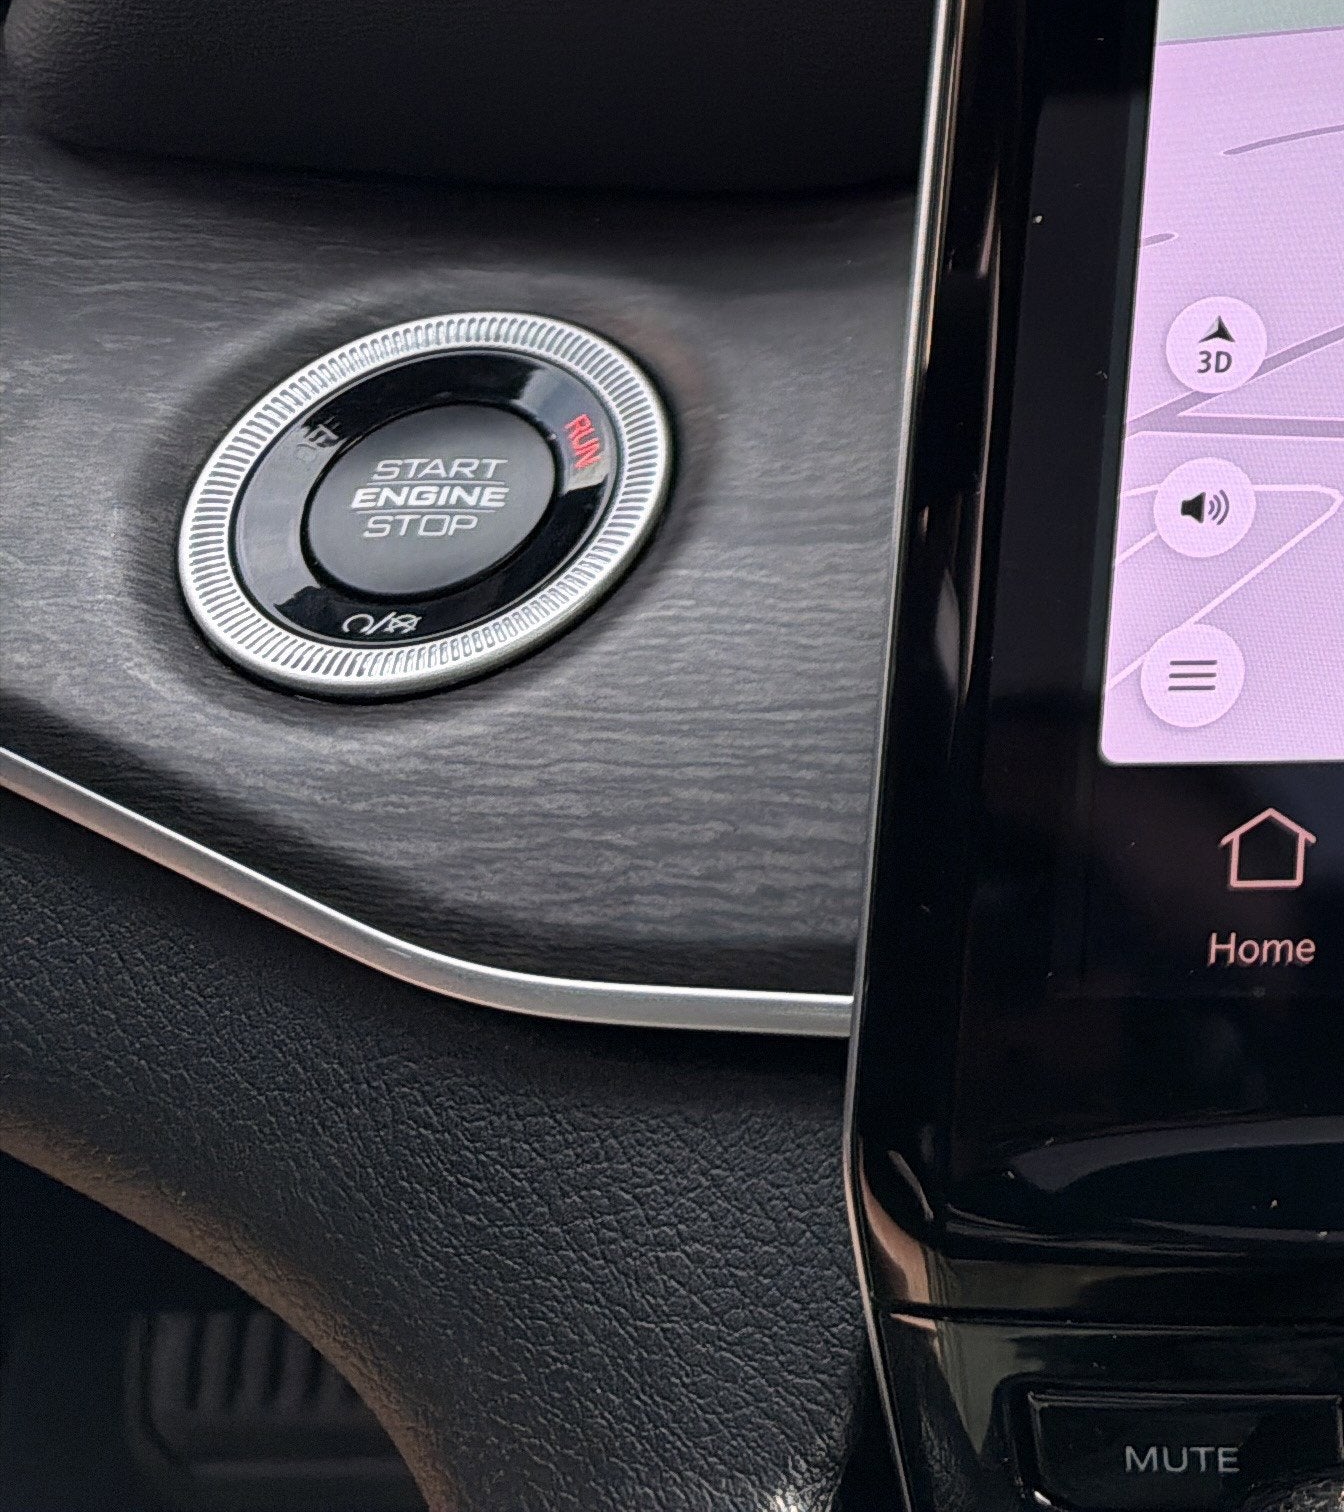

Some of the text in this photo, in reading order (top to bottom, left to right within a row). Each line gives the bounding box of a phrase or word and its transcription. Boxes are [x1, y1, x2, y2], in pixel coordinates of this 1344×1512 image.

[1196, 350, 1233, 374] 3D
[564, 413, 604, 470] RUN
[372, 458, 508, 480] START
[350, 485, 509, 510] ENGINE
[362, 515, 479, 539] STOP
[1208, 931, 1317, 967] Home
[1125, 1445, 1241, 1473] MUTE
